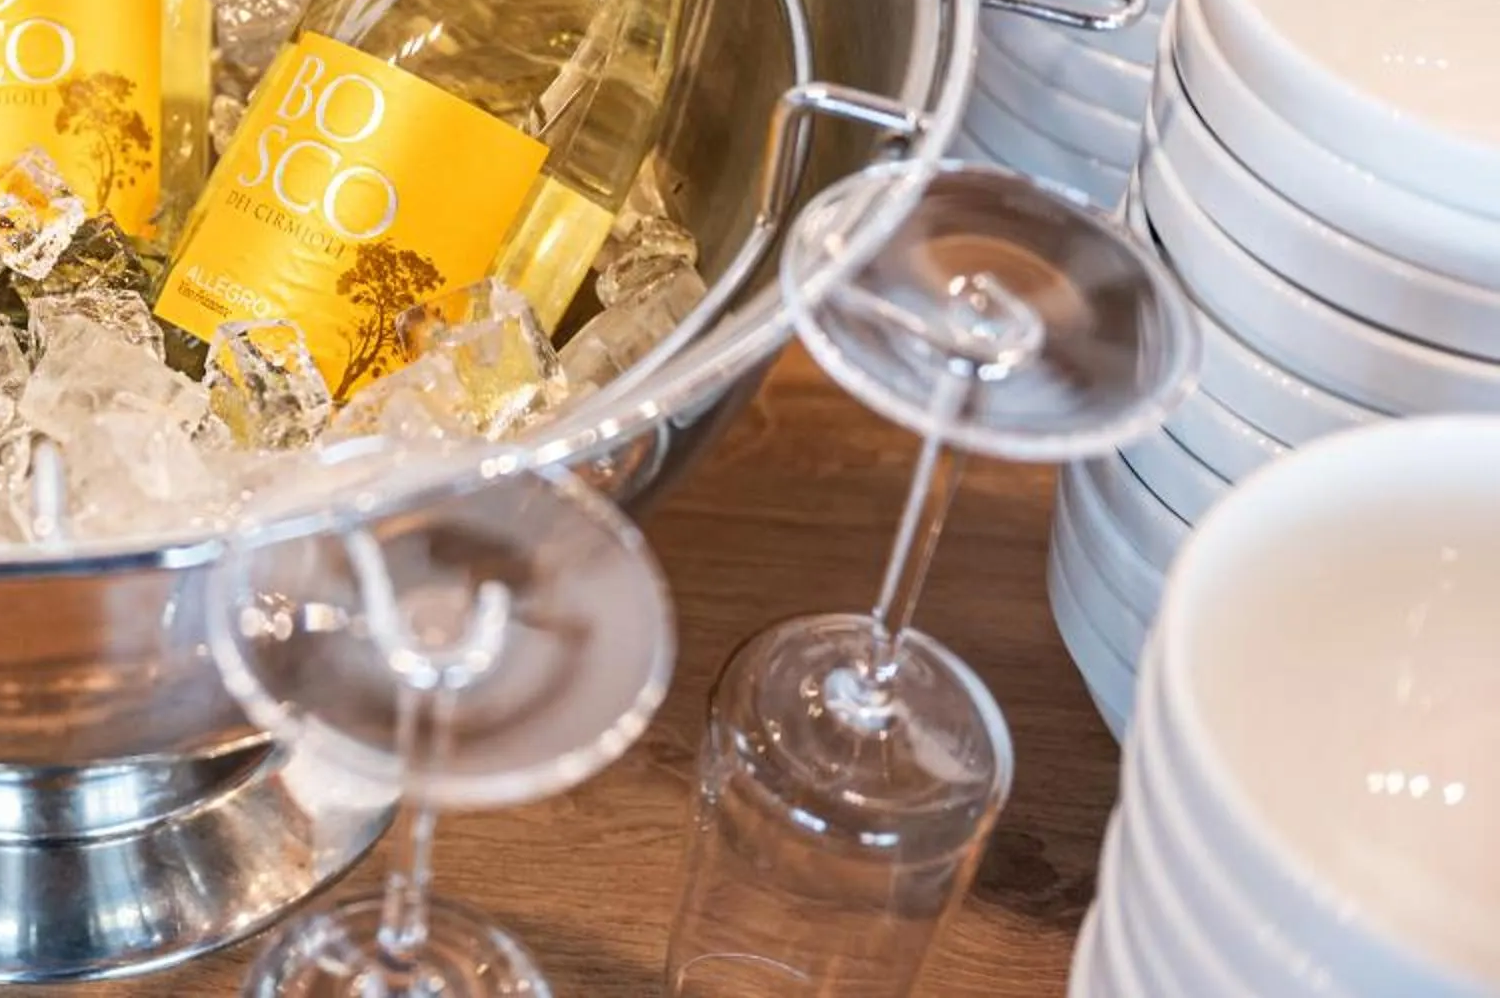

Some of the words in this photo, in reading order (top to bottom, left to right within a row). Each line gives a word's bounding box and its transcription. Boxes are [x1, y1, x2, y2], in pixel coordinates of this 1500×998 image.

[275, 54, 386, 144] BO
[237, 123, 399, 240] SCO
[185, 264, 273, 321] ALLEGRO
